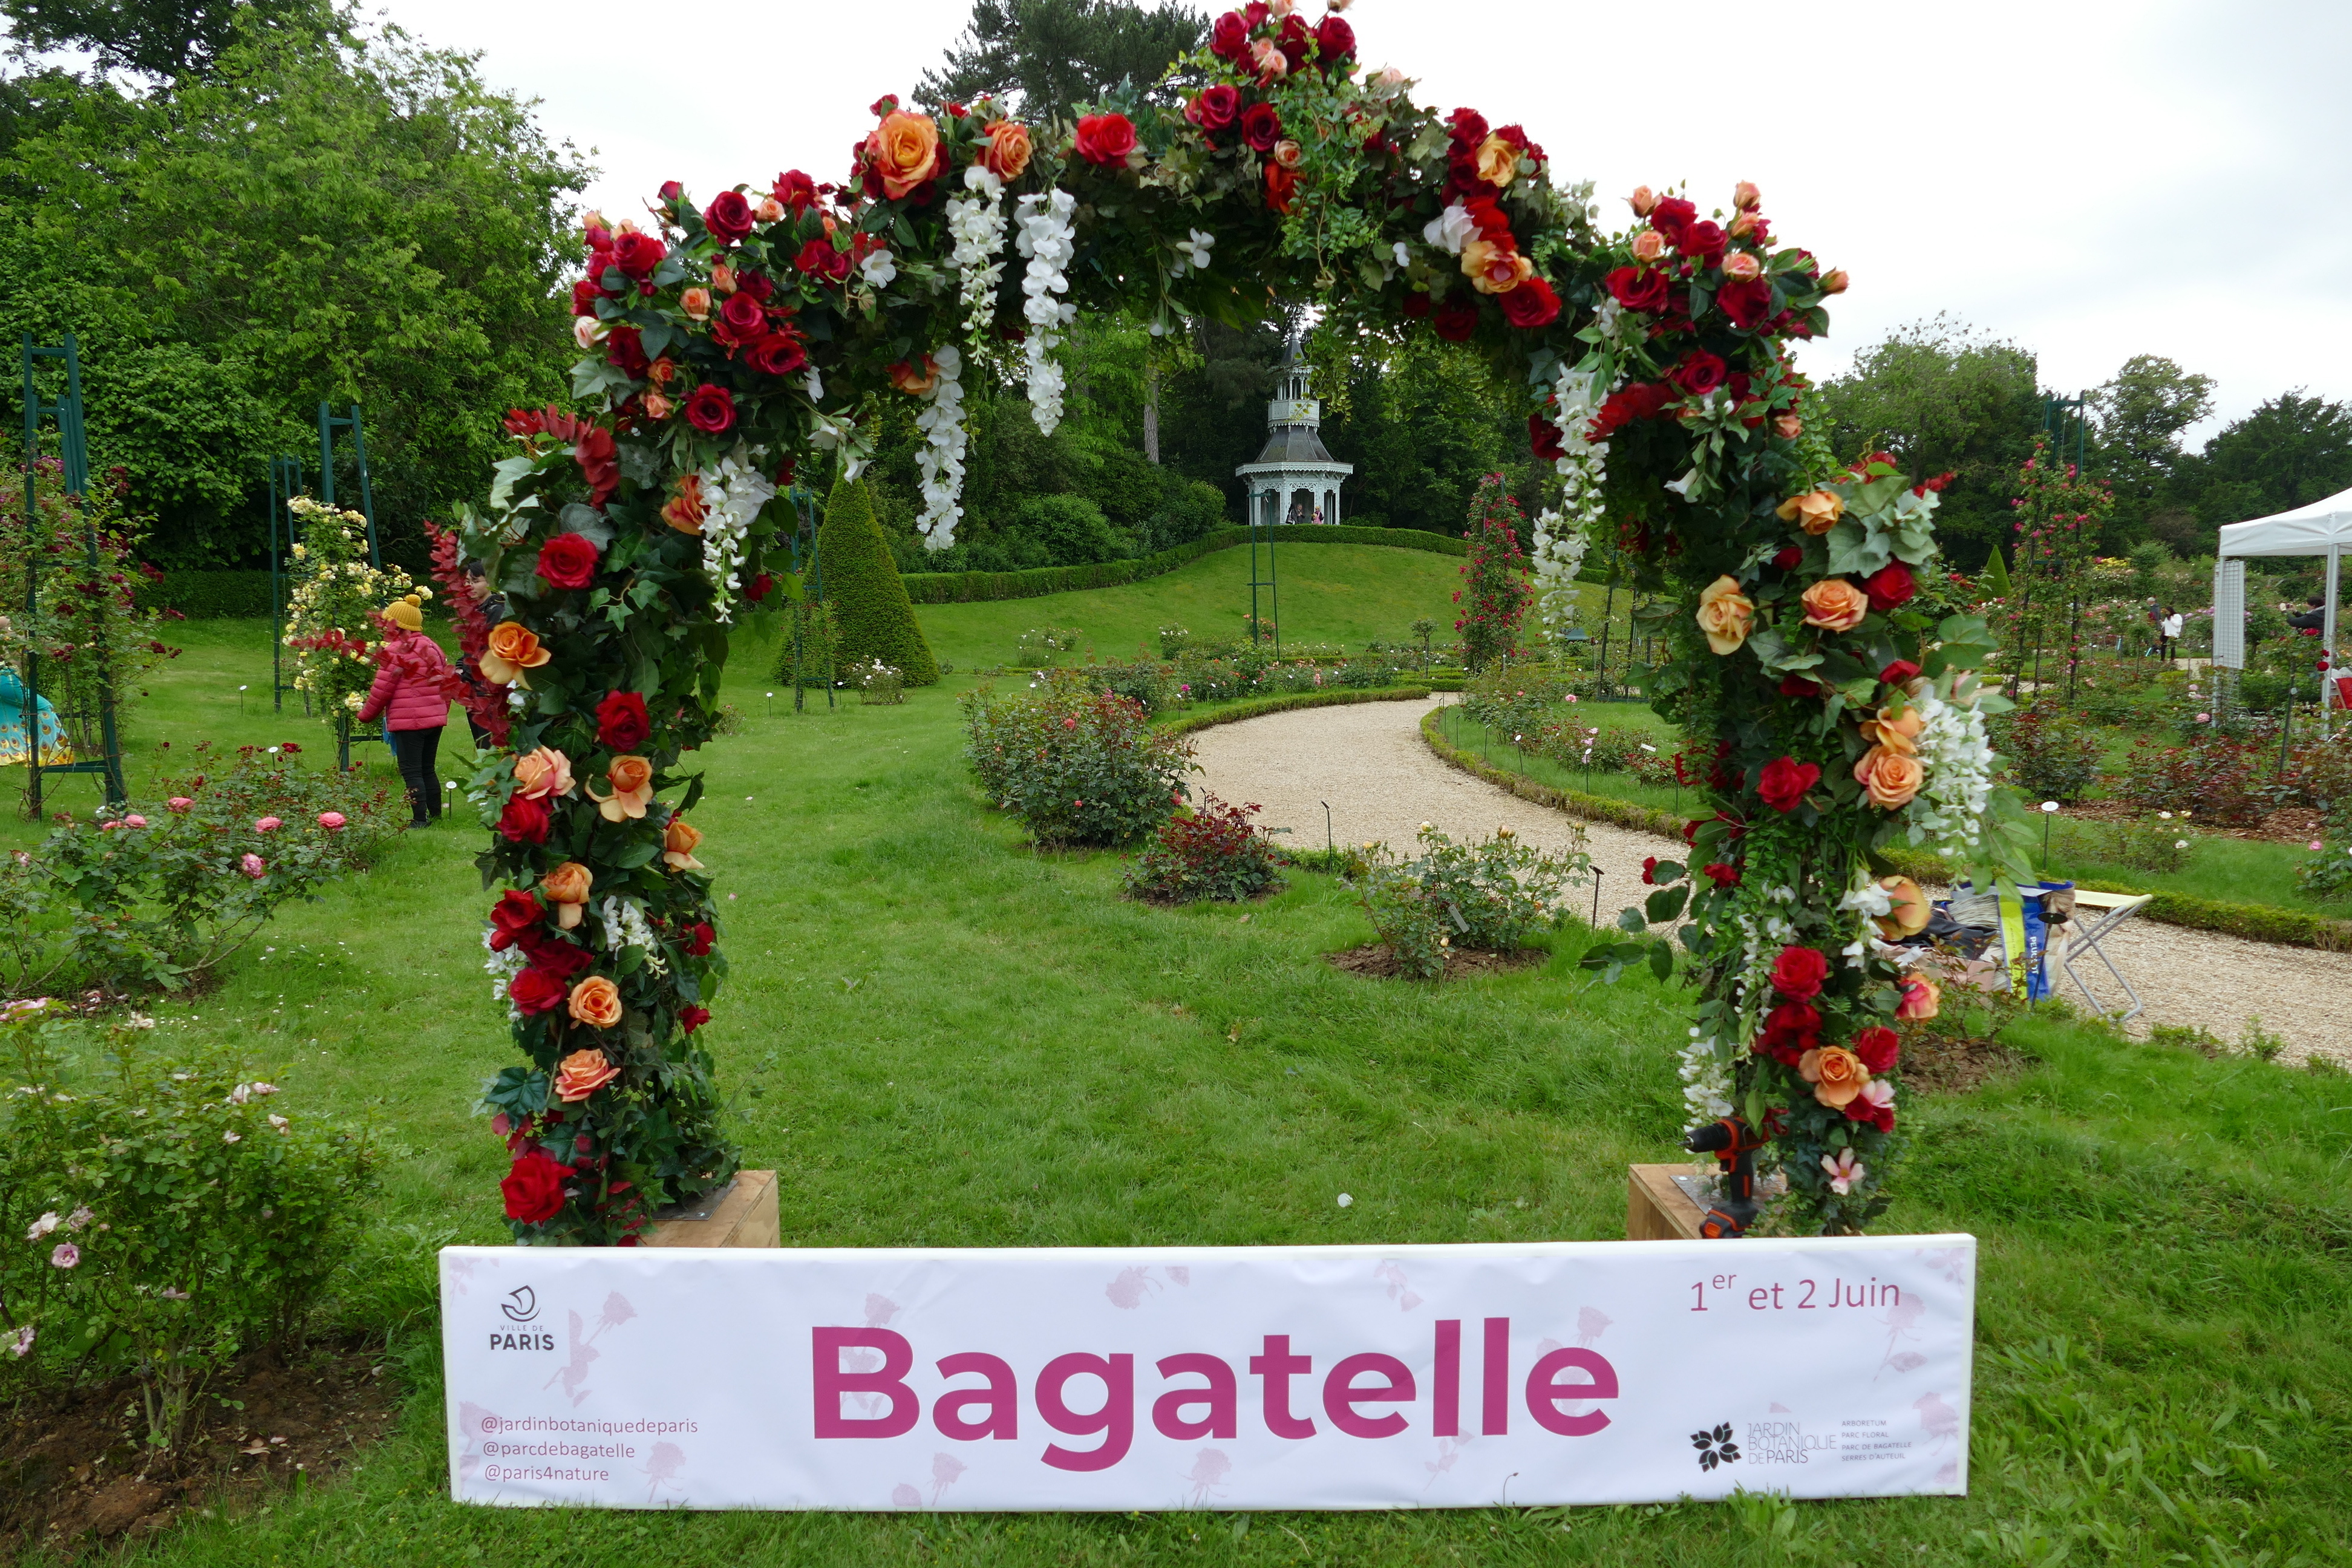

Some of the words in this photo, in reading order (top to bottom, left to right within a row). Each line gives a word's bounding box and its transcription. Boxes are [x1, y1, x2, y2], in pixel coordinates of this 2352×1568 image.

[1748, 1282, 1784, 1310] et
[1797, 1279, 1816, 1309] 2
[1828, 1276, 1900, 1308] Juin
[489, 1333, 555, 1351] PARIS
[812, 1317, 1619, 1472] Bagatelle
[481, 1416, 698, 1436] @jardinbotaniquedeparis
[1747, 1422, 1800, 1437] JARDIN
[483, 1440, 635, 1460] @parcdebagatelle
[1748, 1434, 1837, 1451] BOTANIQUE
[485, 1464, 609, 1483] @paris4nature
